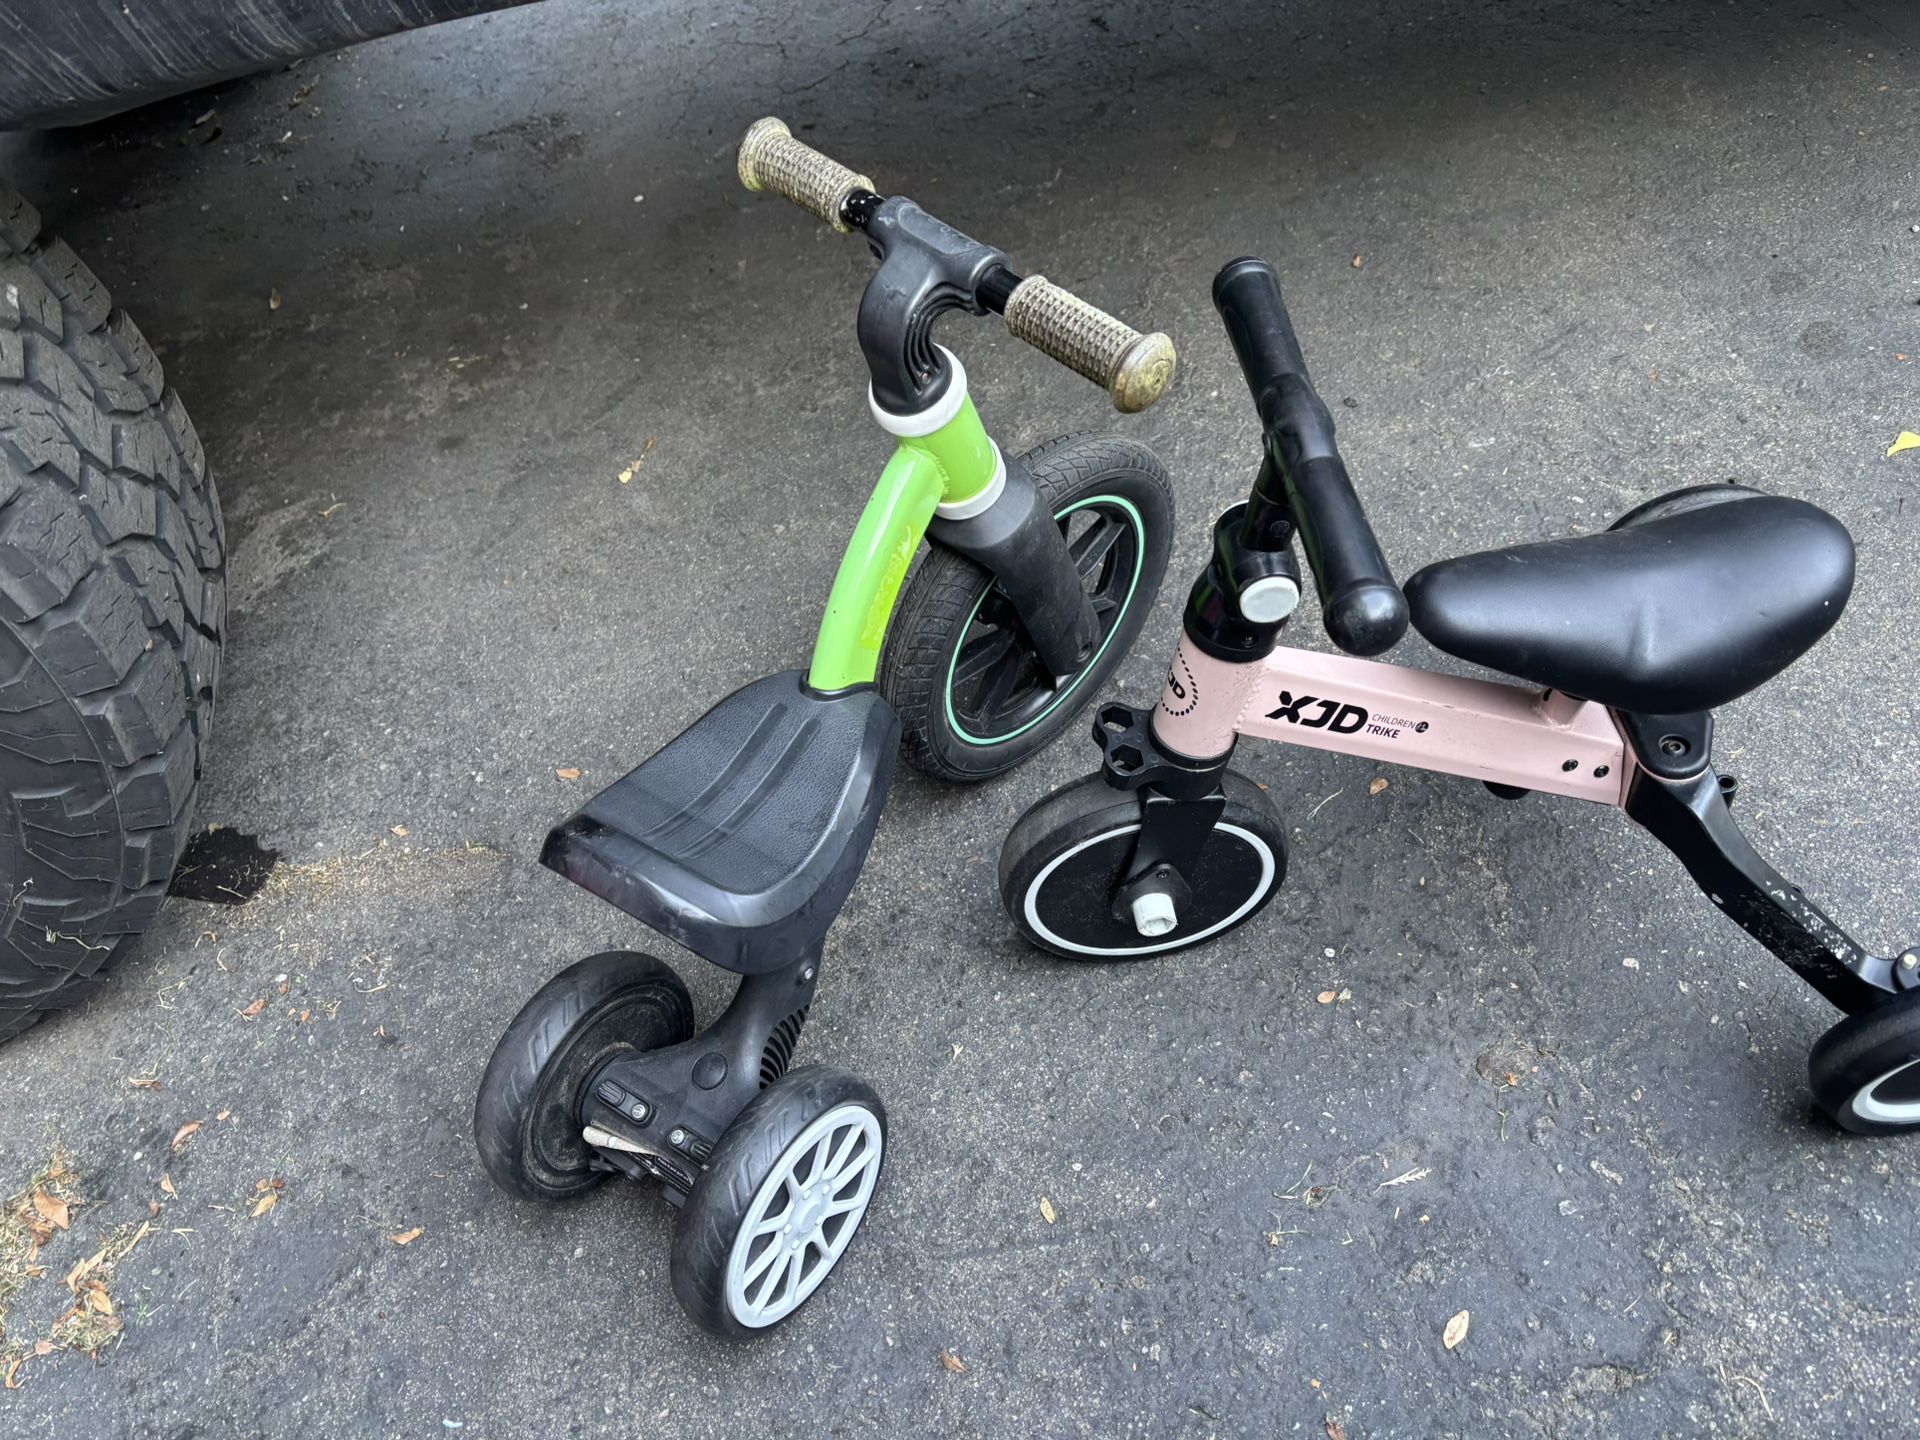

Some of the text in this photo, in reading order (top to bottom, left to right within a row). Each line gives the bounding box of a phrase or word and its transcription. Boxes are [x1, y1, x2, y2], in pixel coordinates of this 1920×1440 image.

[1168, 664, 1186, 699] JD
[1265, 691, 1368, 734] XJD
[1371, 713, 1416, 729] CHILDREN
[1366, 723, 1401, 739] TRIKE
